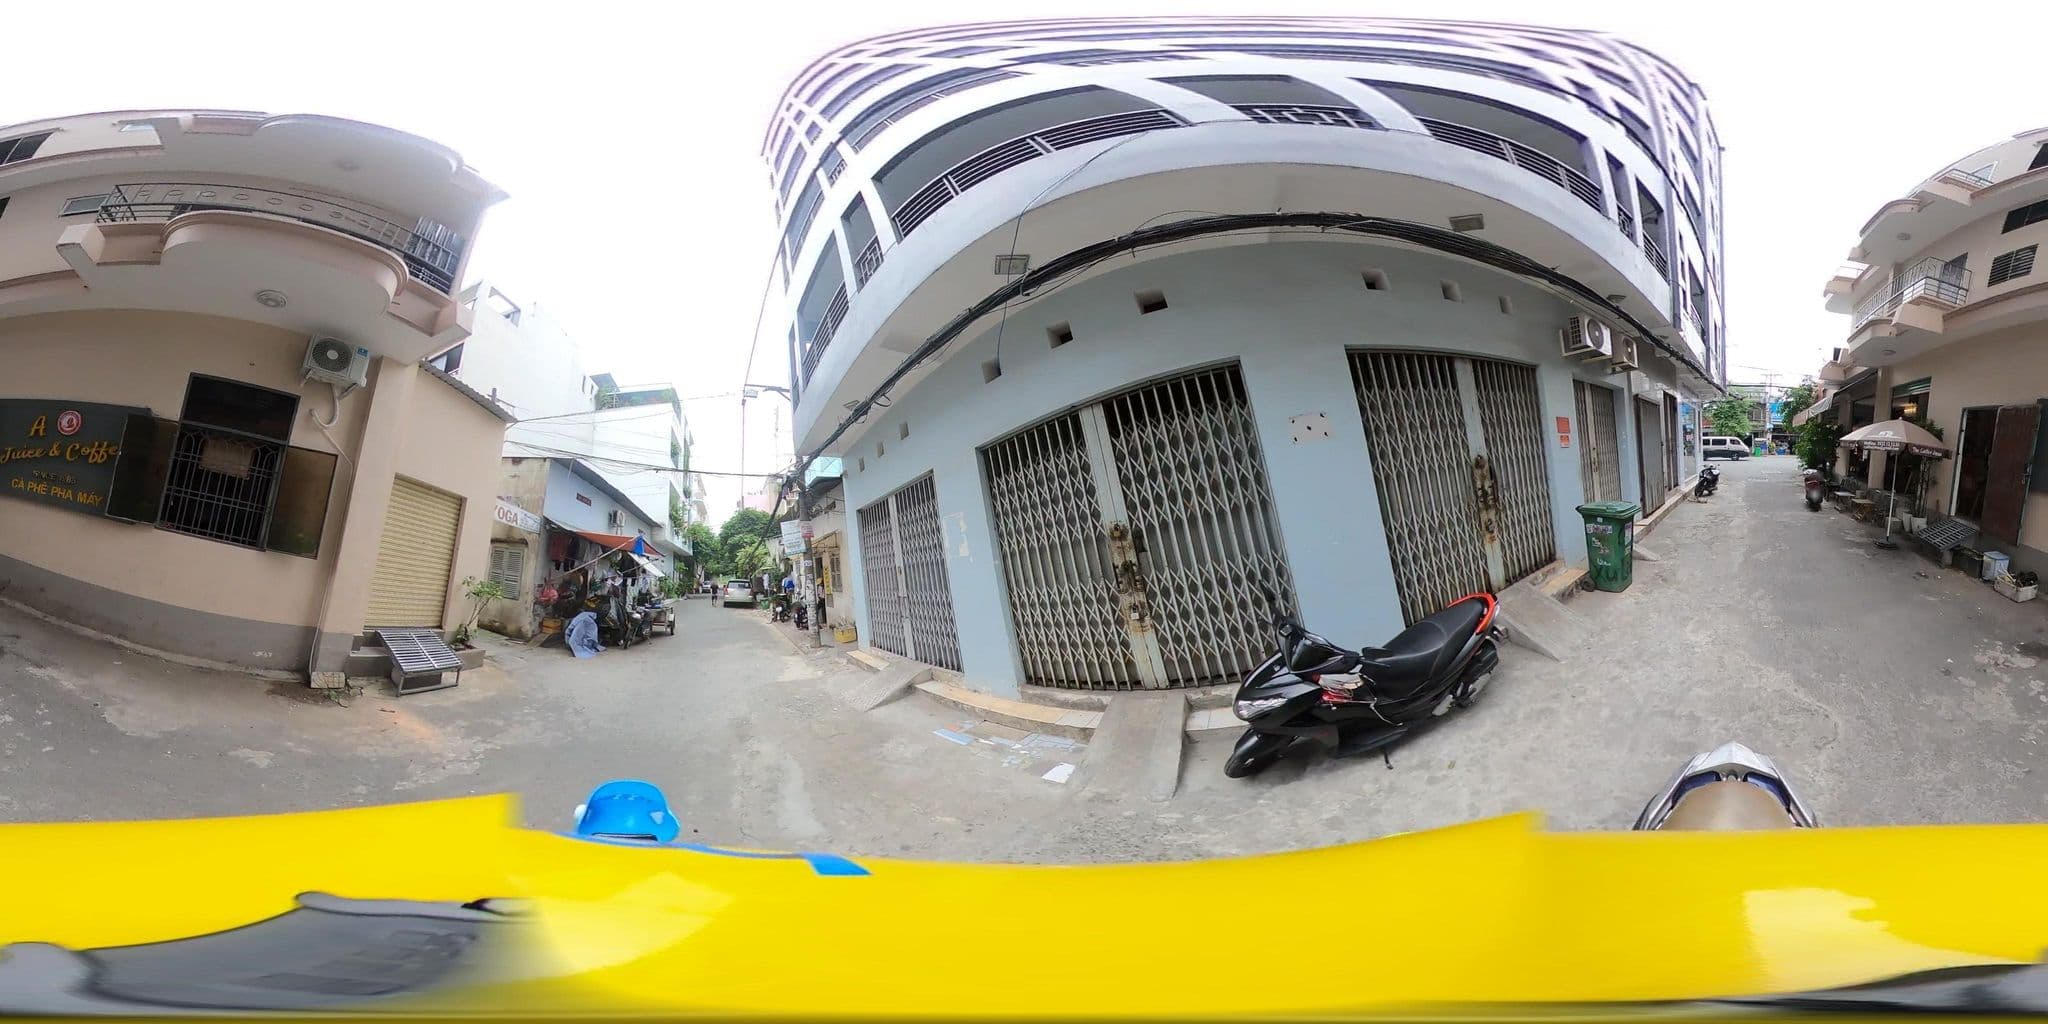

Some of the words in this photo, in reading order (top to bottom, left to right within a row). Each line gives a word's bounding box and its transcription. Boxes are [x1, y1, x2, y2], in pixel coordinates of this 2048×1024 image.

[28, 415, 46, 437] A
[0, 444, 45, 464] Juice
[48, 441, 60, 457] &
[50, 486, 73, 501] PHA
